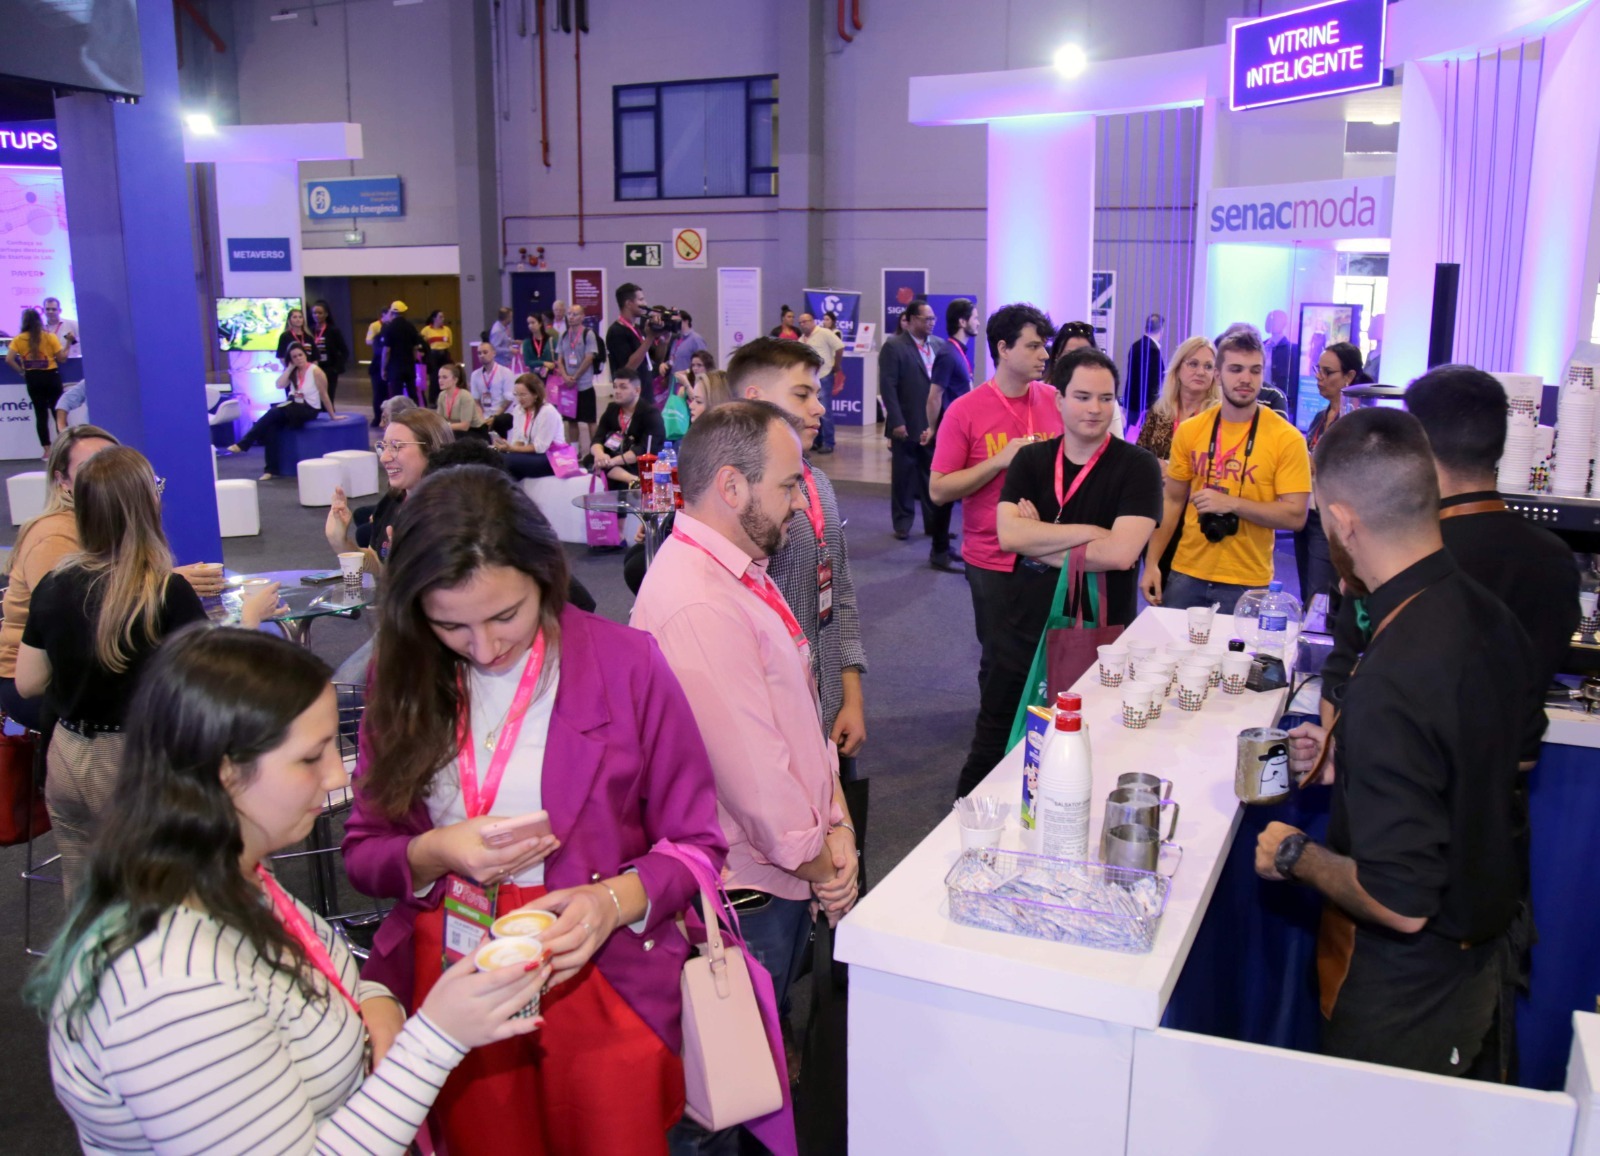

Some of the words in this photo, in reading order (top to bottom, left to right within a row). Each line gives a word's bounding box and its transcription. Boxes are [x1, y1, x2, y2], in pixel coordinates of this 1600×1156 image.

[1268, 20, 1340, 56] VITRINE
[1246, 45, 1364, 89] INTELIGENTE
[0, 131, 58, 151] TUPS
[1210, 186, 1376, 232] senacmoda
[232, 250, 285, 259] METAVERSO
